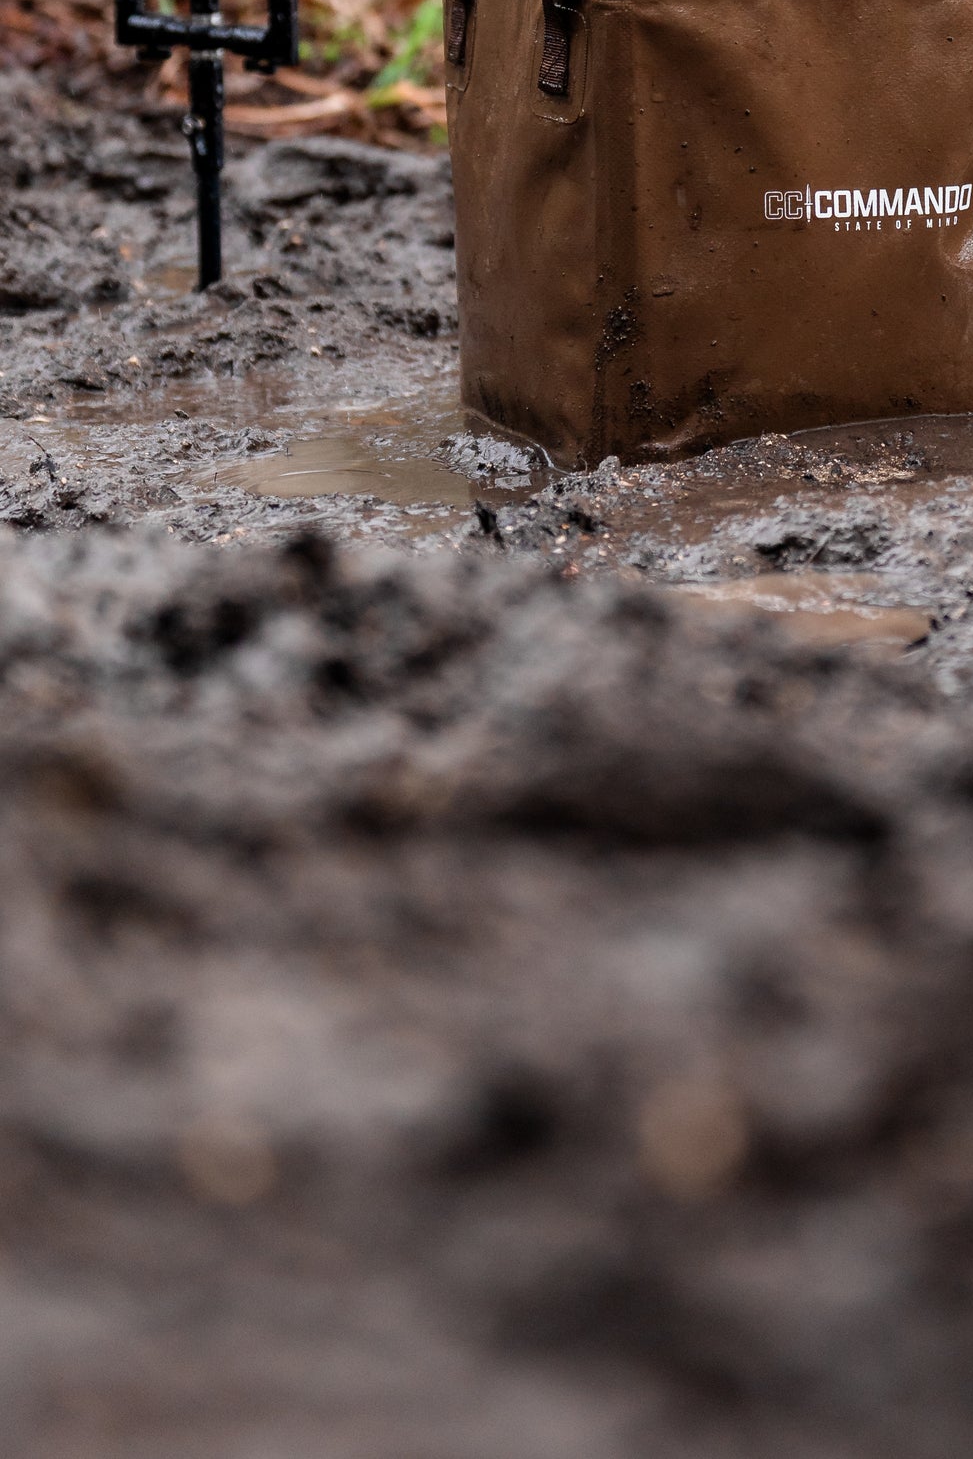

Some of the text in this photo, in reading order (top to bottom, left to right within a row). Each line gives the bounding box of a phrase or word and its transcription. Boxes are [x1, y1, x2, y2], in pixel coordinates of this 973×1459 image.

[764, 183, 973, 220] CC COMMANDO
[834, 215, 959, 232] STATE OF MIND
